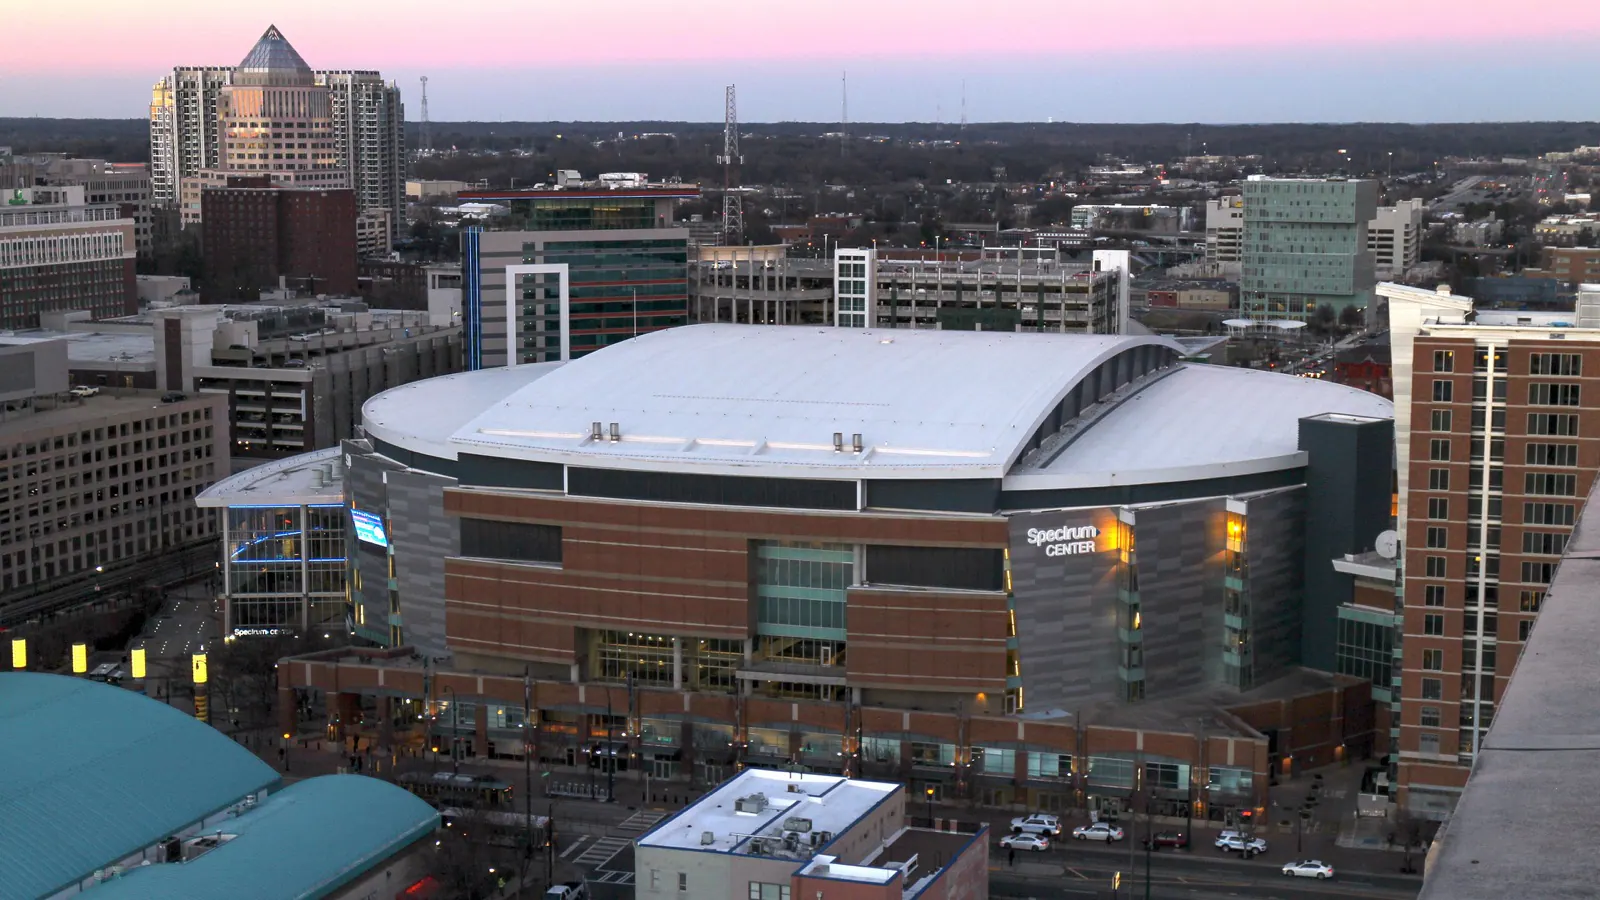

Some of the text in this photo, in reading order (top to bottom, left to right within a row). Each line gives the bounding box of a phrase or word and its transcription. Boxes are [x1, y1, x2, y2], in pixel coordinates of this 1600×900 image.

[1027, 526, 1096, 546] Spectrum
[1046, 541, 1095, 556] CENTER
[234, 628, 267, 636] Spectrum
